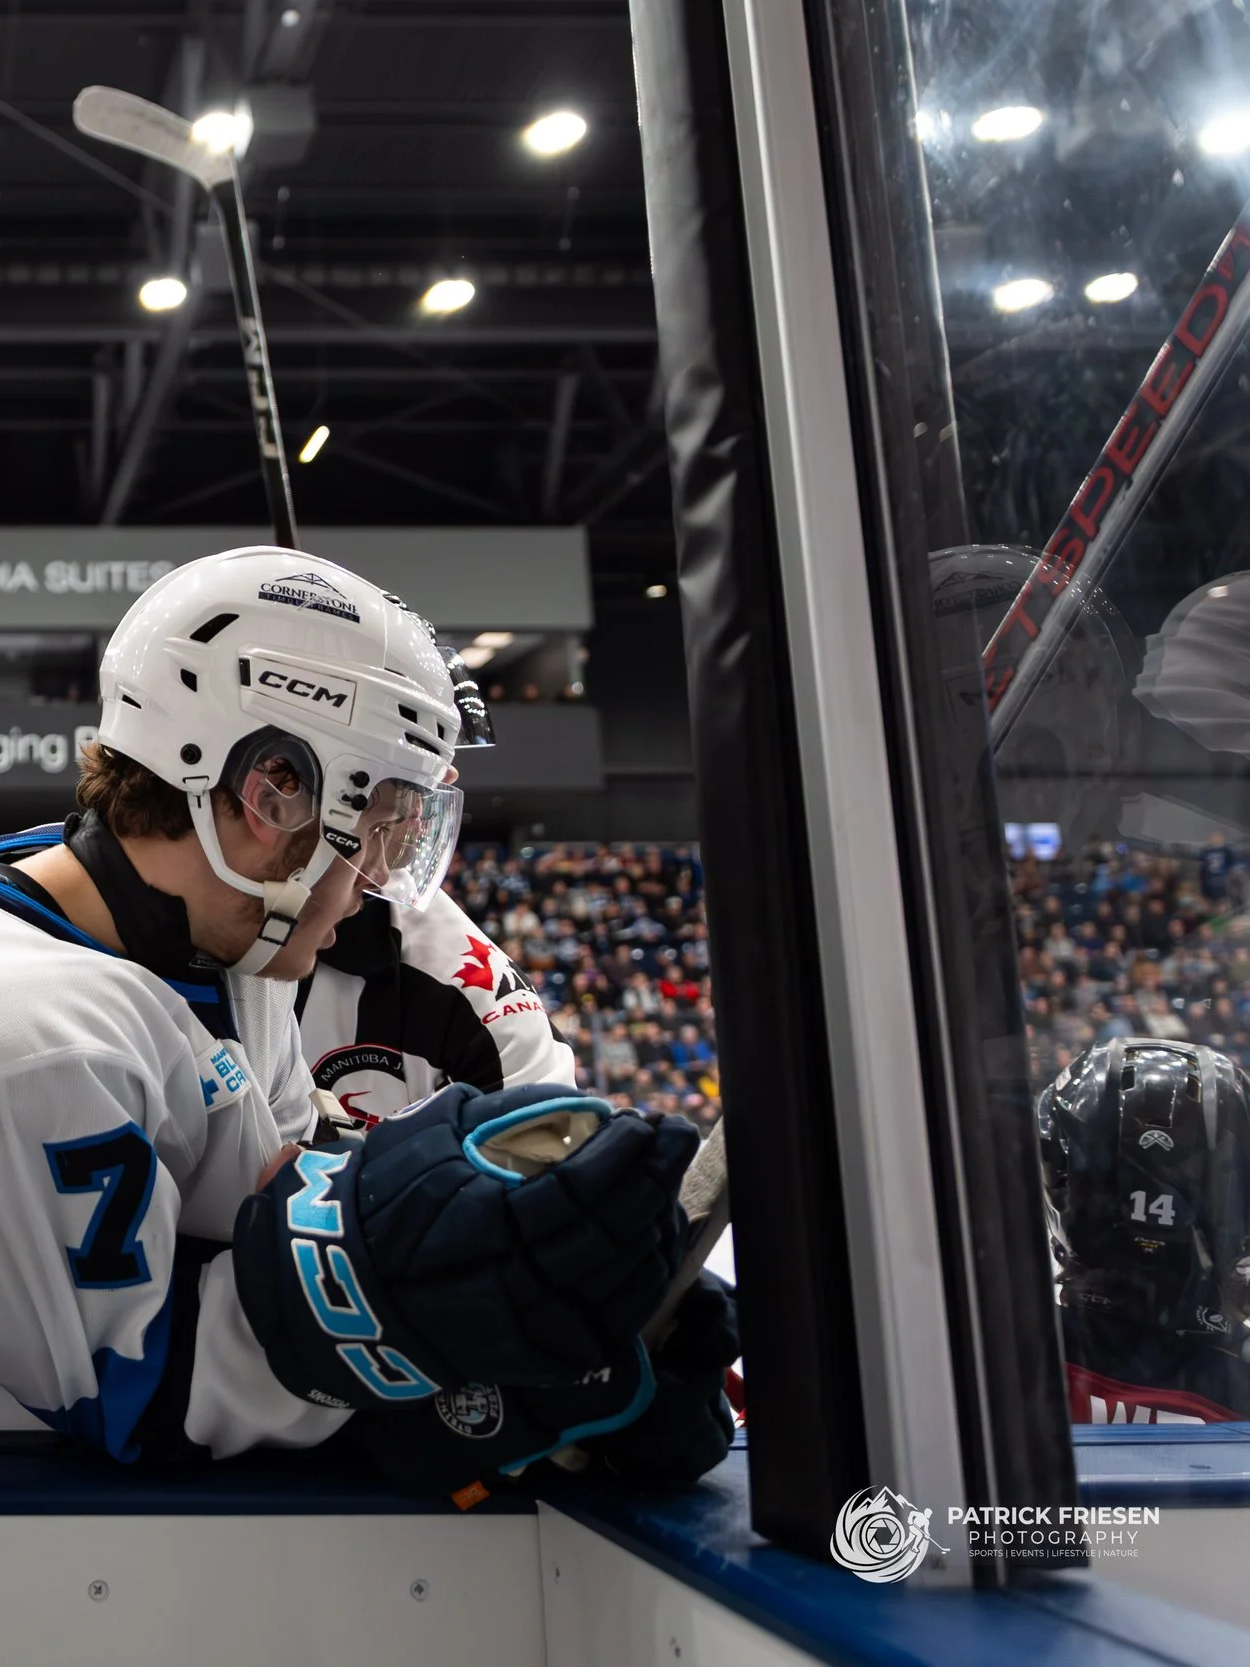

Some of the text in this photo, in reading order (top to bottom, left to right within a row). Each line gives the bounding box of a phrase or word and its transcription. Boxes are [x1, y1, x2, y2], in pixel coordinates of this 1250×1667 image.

[985, 283, 1228, 706] ETSPEED
[44, 561, 175, 593] SUITES
[258, 670, 348, 708] CCM
[325, 832, 359, 849] CCM
[482, 1001, 543, 1025] CANA
[321, 1053, 390, 1082] MANITOBA
[43, 1121, 157, 1289] 7
[1129, 1190, 1176, 1226] 14
[287, 1150, 442, 1400] CCM
